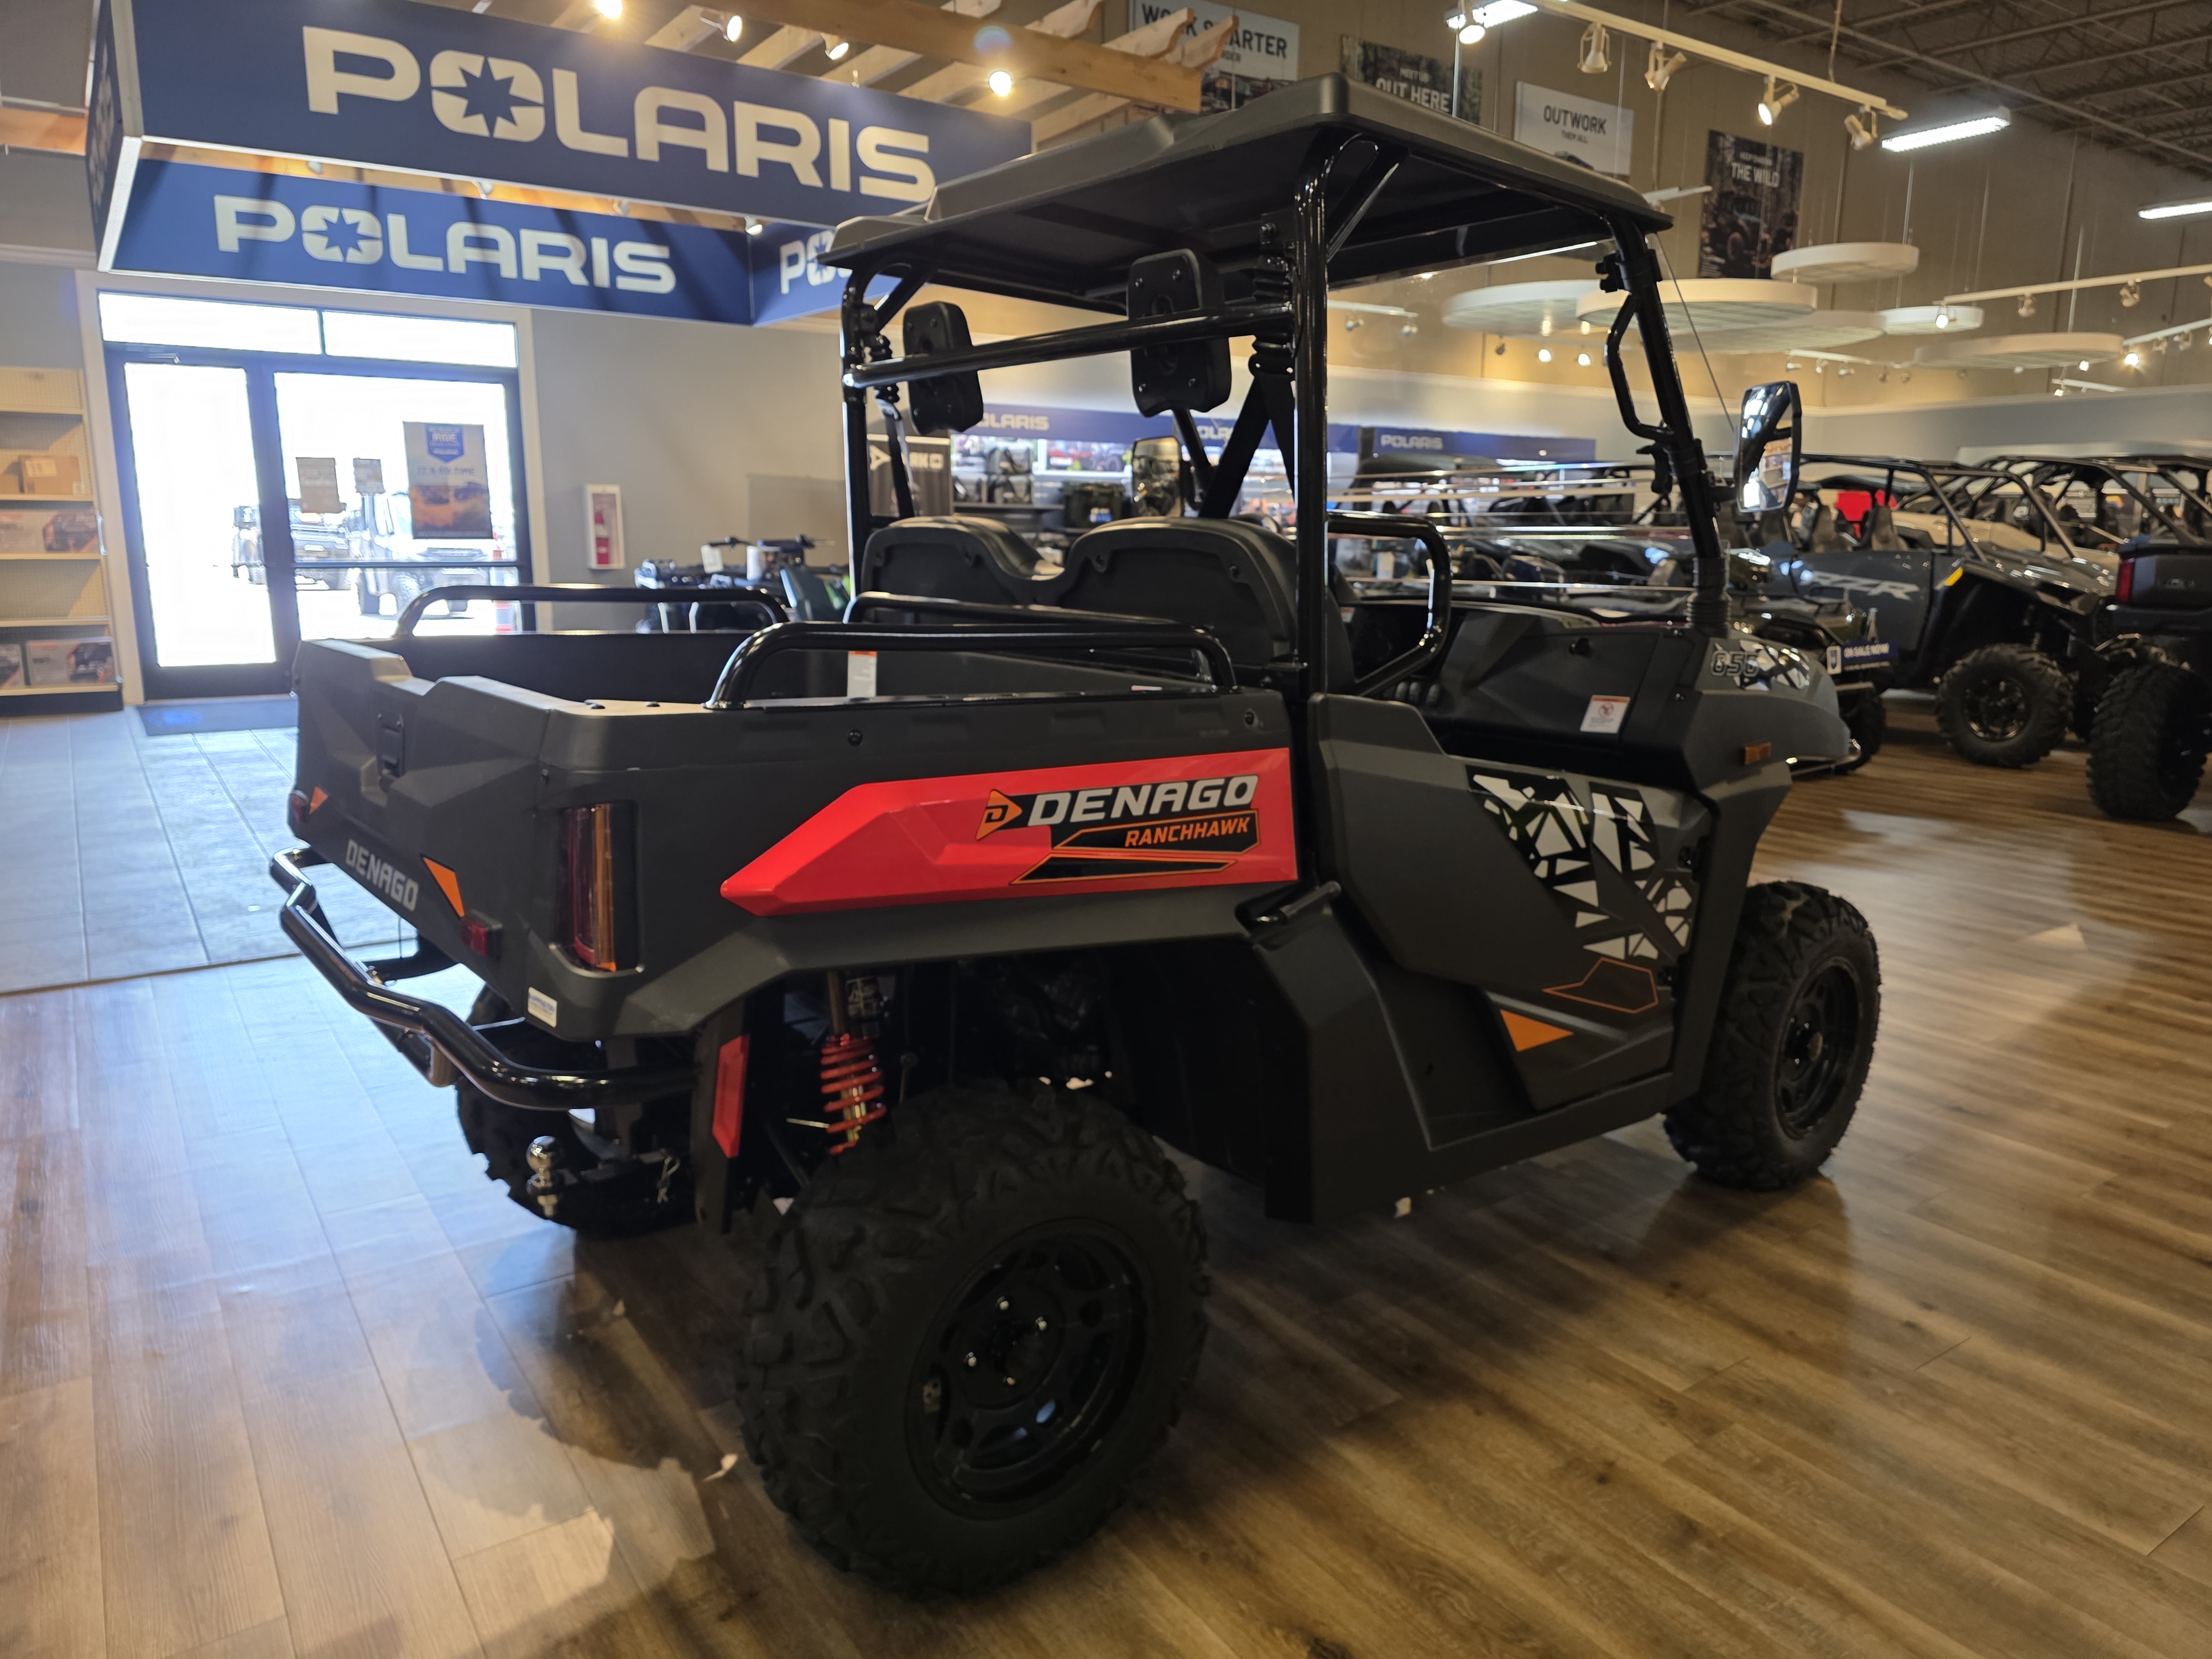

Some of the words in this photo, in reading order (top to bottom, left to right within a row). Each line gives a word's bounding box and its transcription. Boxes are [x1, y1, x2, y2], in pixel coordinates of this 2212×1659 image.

[1141, 3, 1198, 36] WK
[302, 25, 936, 202] POLARIS
[1411, 85, 1451, 112] HERE
[1543, 105, 1607, 135] OUTWORK
[1731, 161, 1752, 181] THE
[1754, 166, 1780, 188] WILD
[213, 194, 676, 294] POLARIS
[976, 412, 1050, 431] OLARIS
[1380, 434, 1443, 450] POLARIS
[1027, 775, 1259, 826] DENAGO
[1125, 817, 1250, 847] RANCHHAWK
[346, 838, 419, 912] DENAGO
